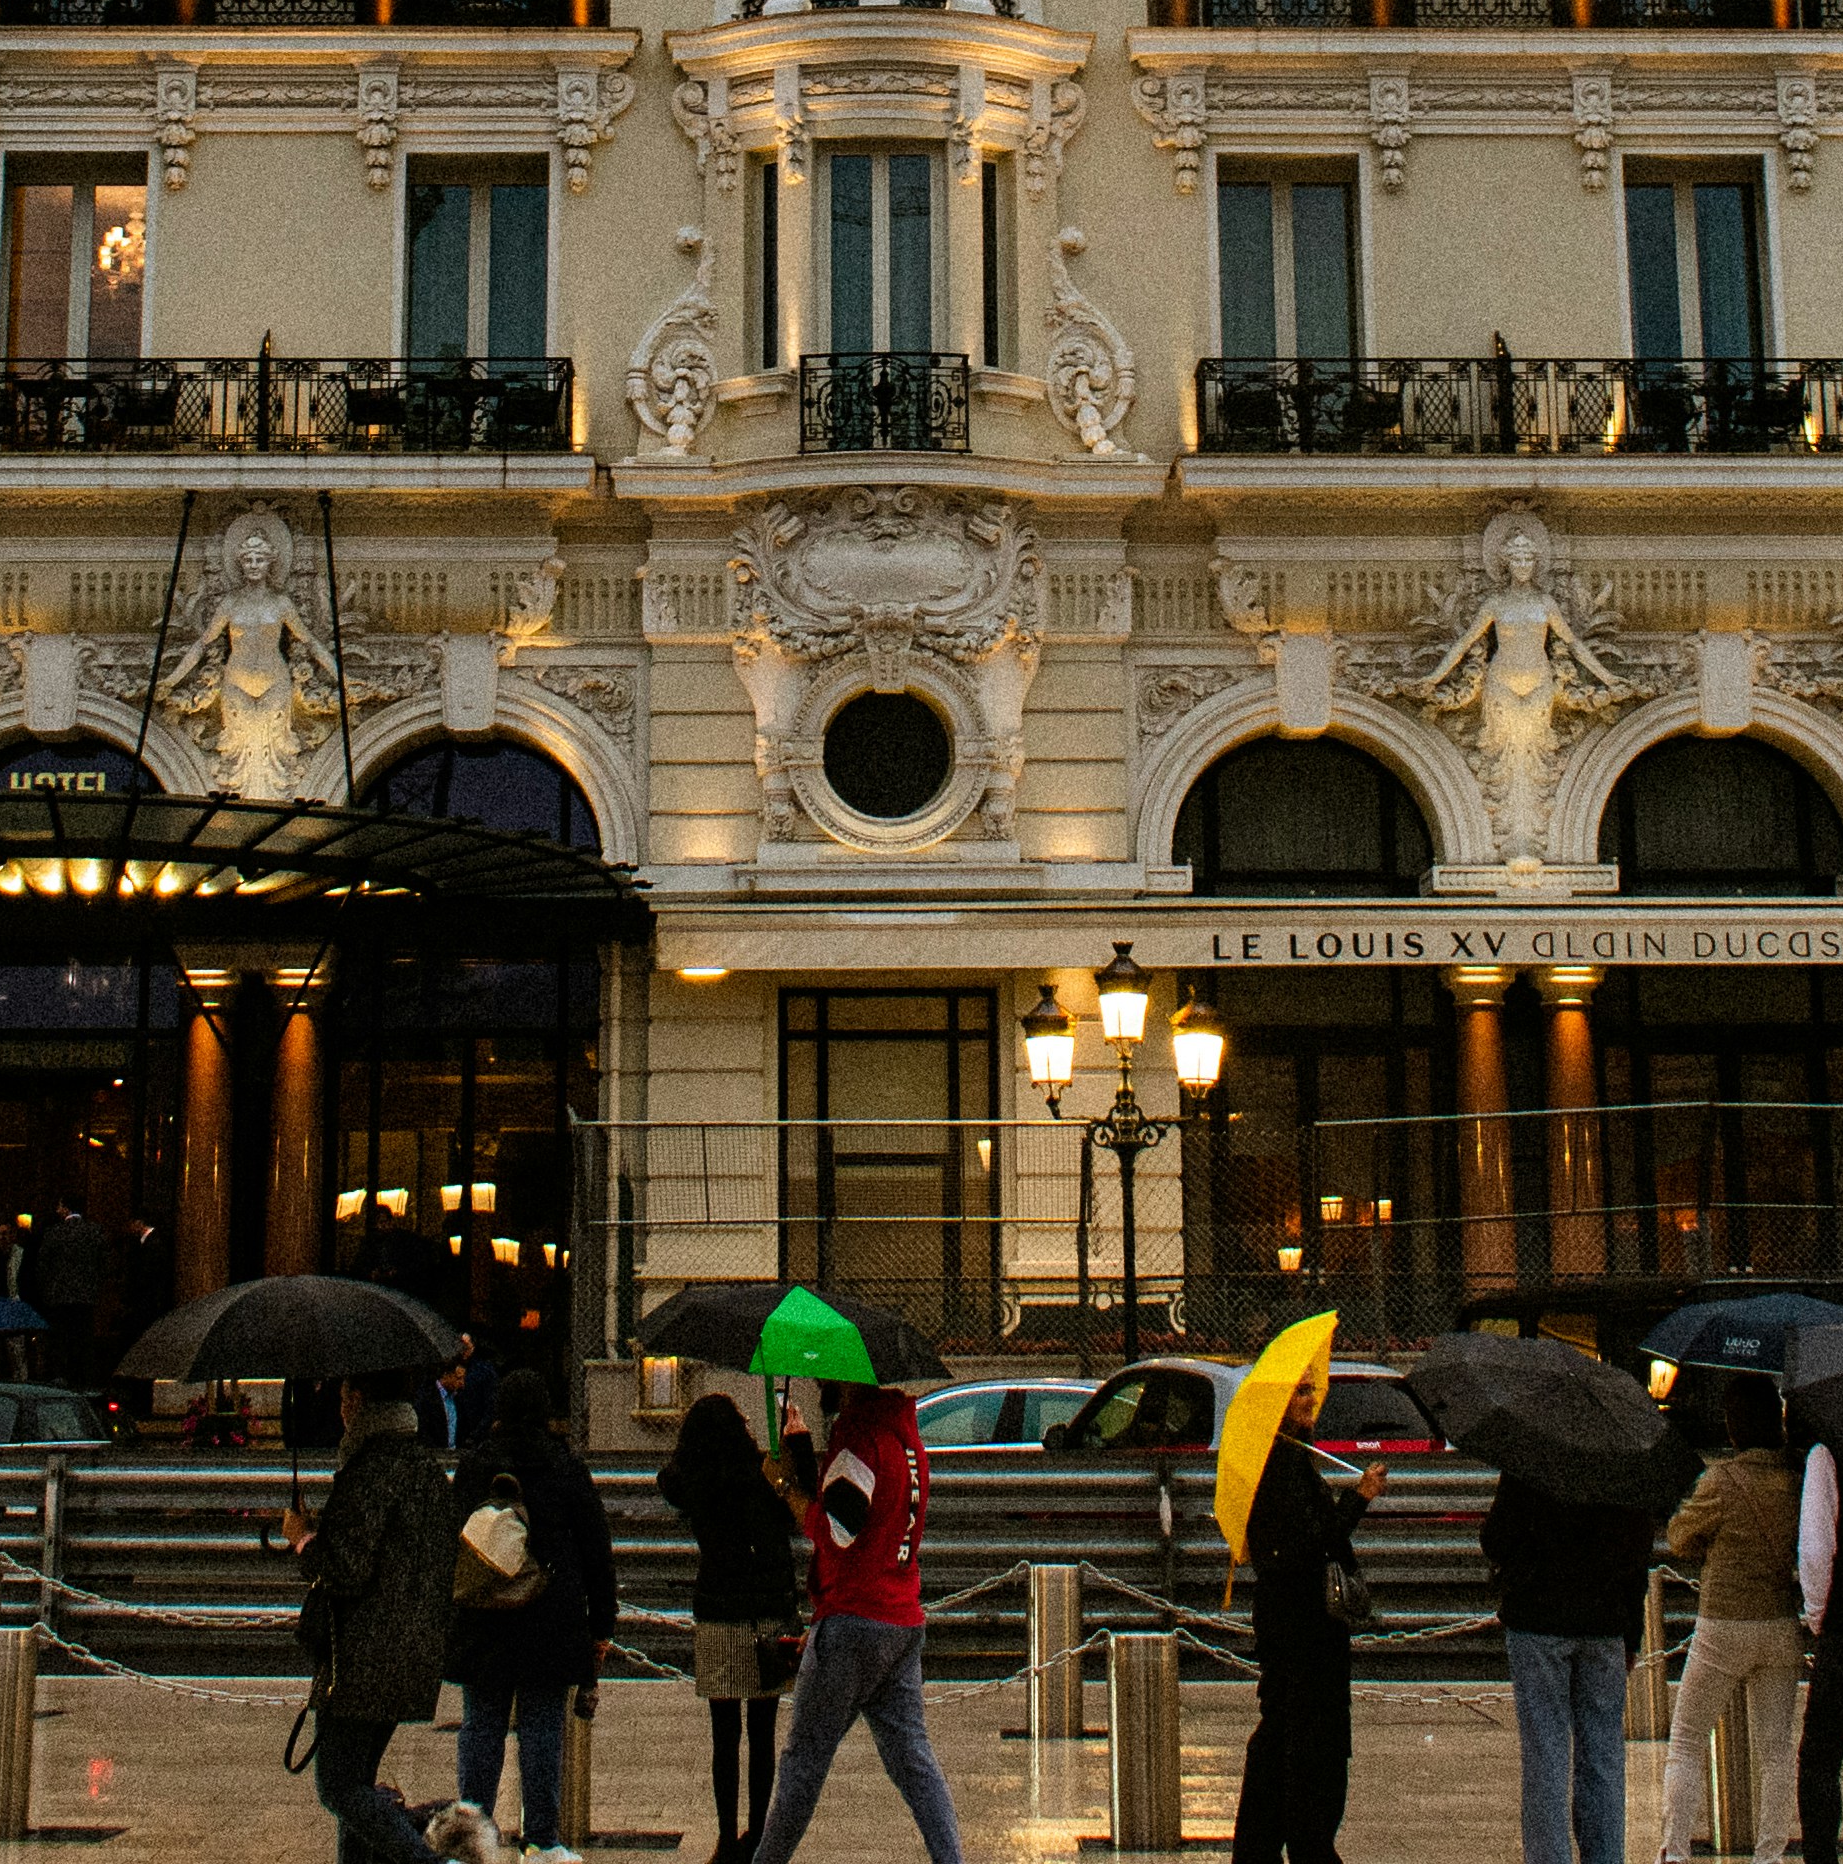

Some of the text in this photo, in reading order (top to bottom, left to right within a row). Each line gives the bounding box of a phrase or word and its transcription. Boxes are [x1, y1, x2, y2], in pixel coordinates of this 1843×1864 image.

[1212, 933, 1262, 960] LE
[1289, 932, 1425, 959] LOUIS
[1450, 931, 1506, 958] XV
